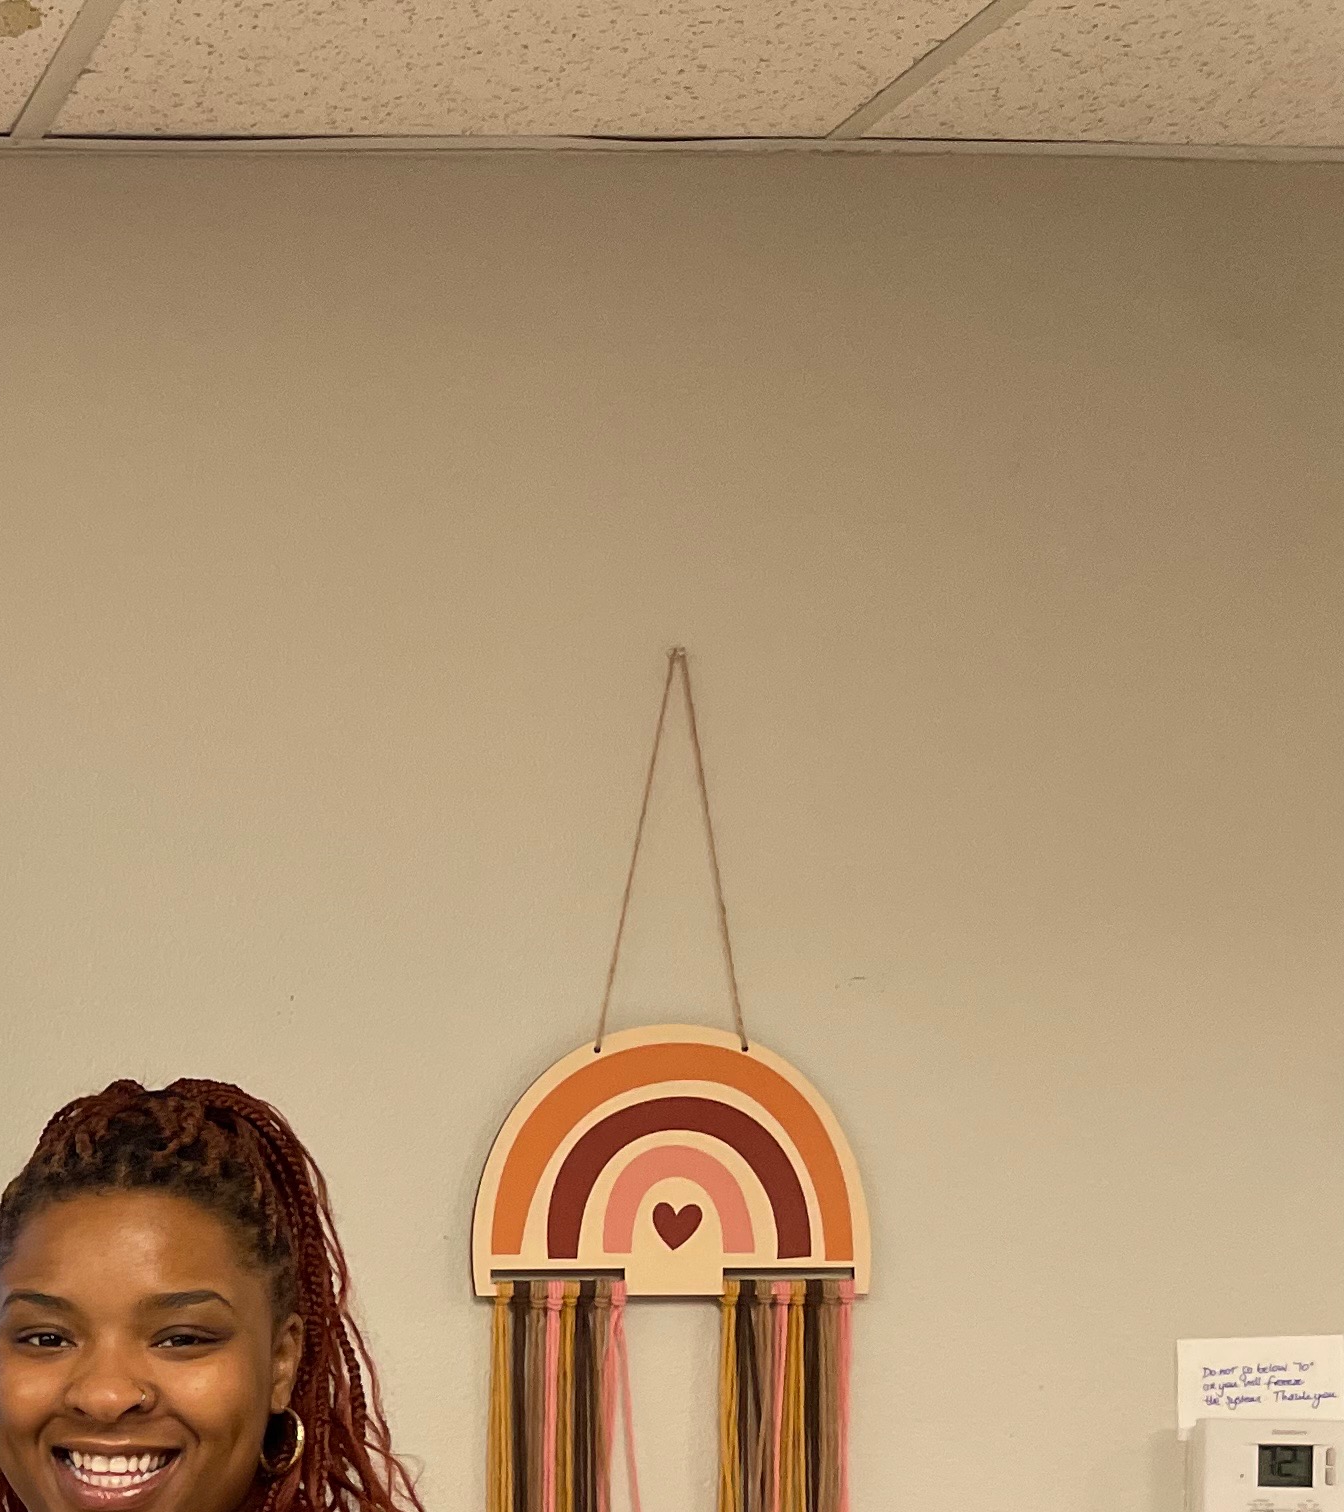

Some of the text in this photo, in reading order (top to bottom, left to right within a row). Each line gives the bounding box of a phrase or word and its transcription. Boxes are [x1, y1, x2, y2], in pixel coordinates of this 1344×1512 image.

[1203, 1366, 1216, 1378] Do
[1219, 1366, 1238, 1375] not
[1239, 1365, 1253, 1382] go
[1256, 1363, 1288, 1374] below
[1215, 1381, 1238, 1398] you
[1204, 1395, 1220, 1406] the
[1311, 1391, 1338, 1409] you
